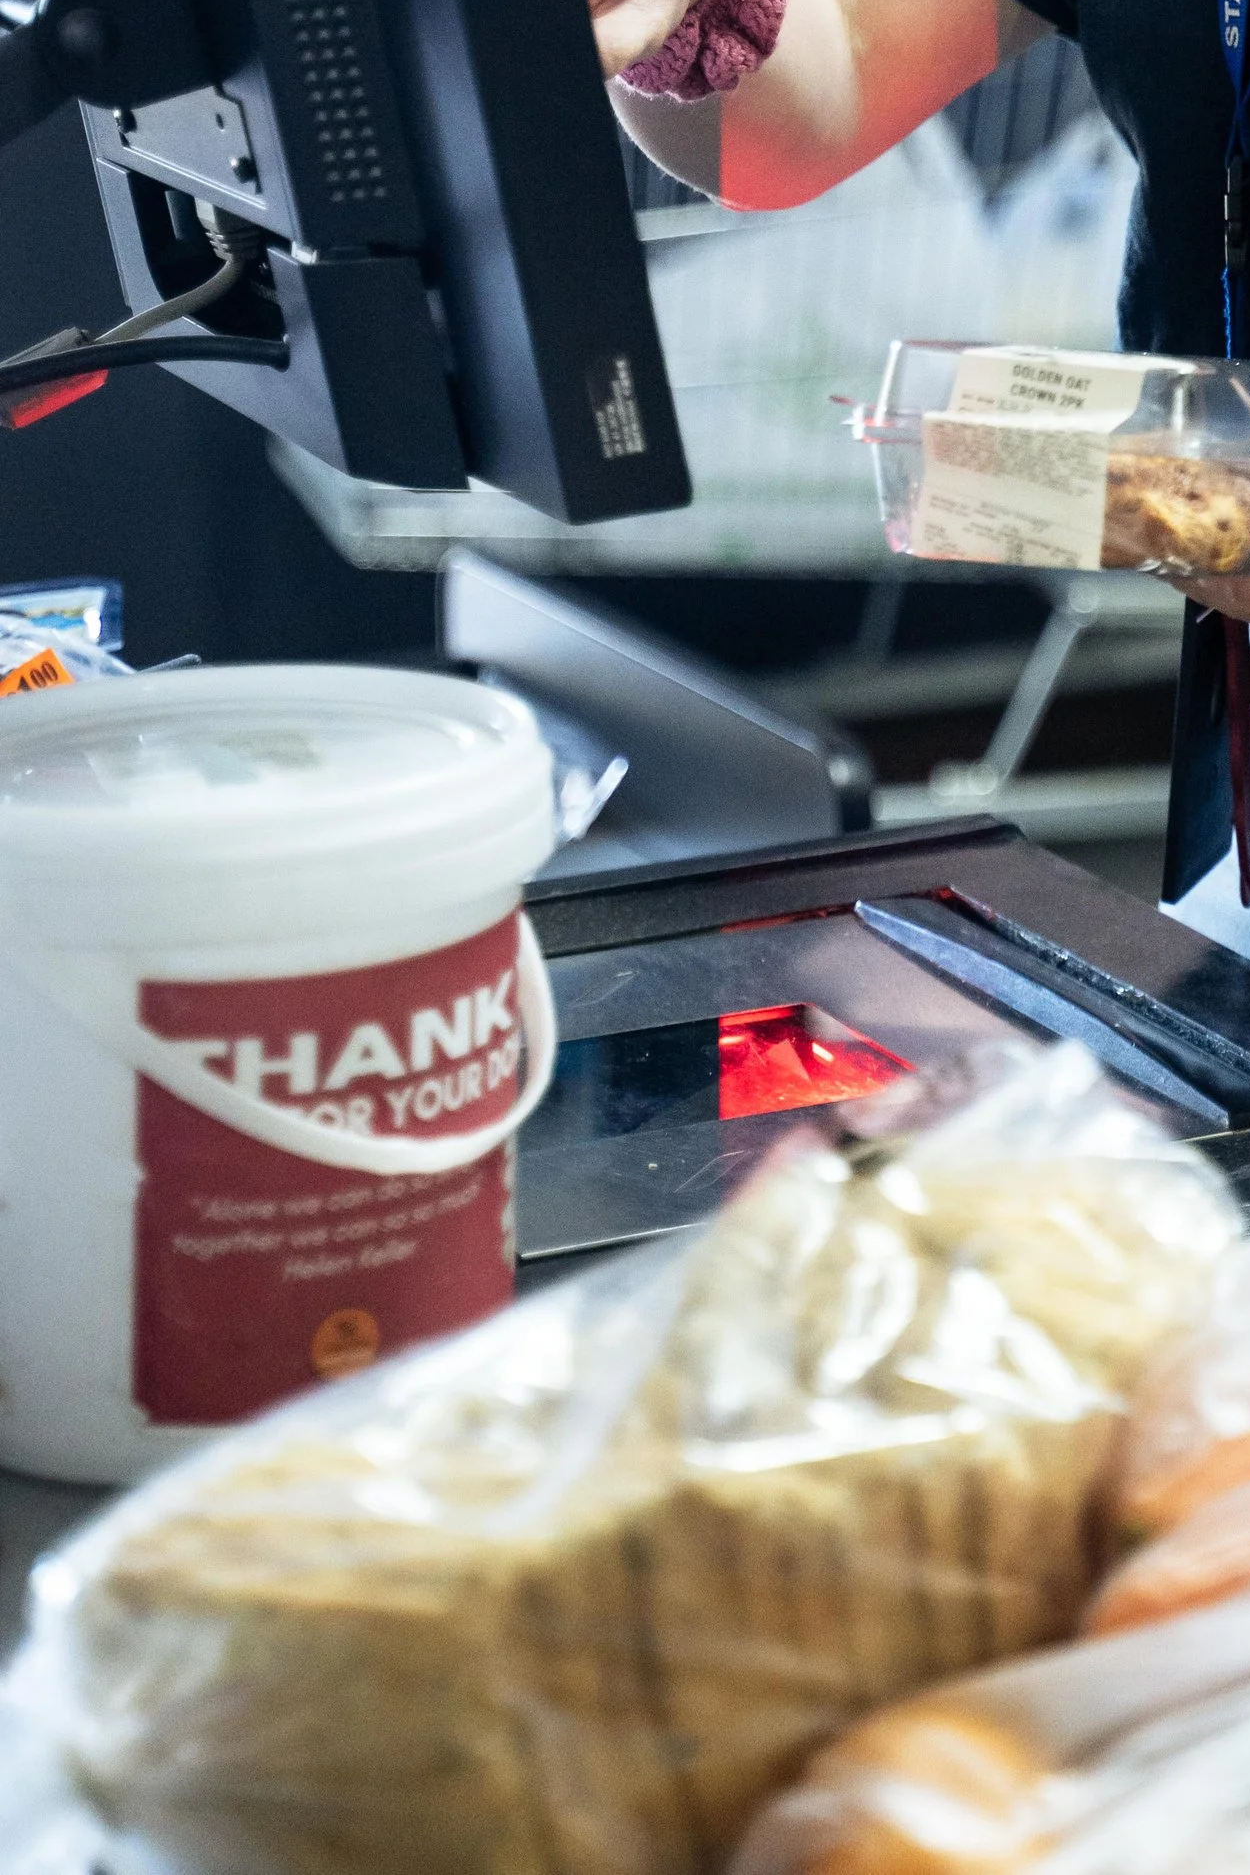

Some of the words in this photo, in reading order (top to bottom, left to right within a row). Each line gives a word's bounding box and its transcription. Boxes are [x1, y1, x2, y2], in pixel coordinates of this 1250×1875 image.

[1012, 364, 1064, 384] GOLDEN
[1065, 376, 1092, 392] OAT
[1010, 383, 1057, 403] CROWN
[386, 1060, 481, 1129] YOUR
